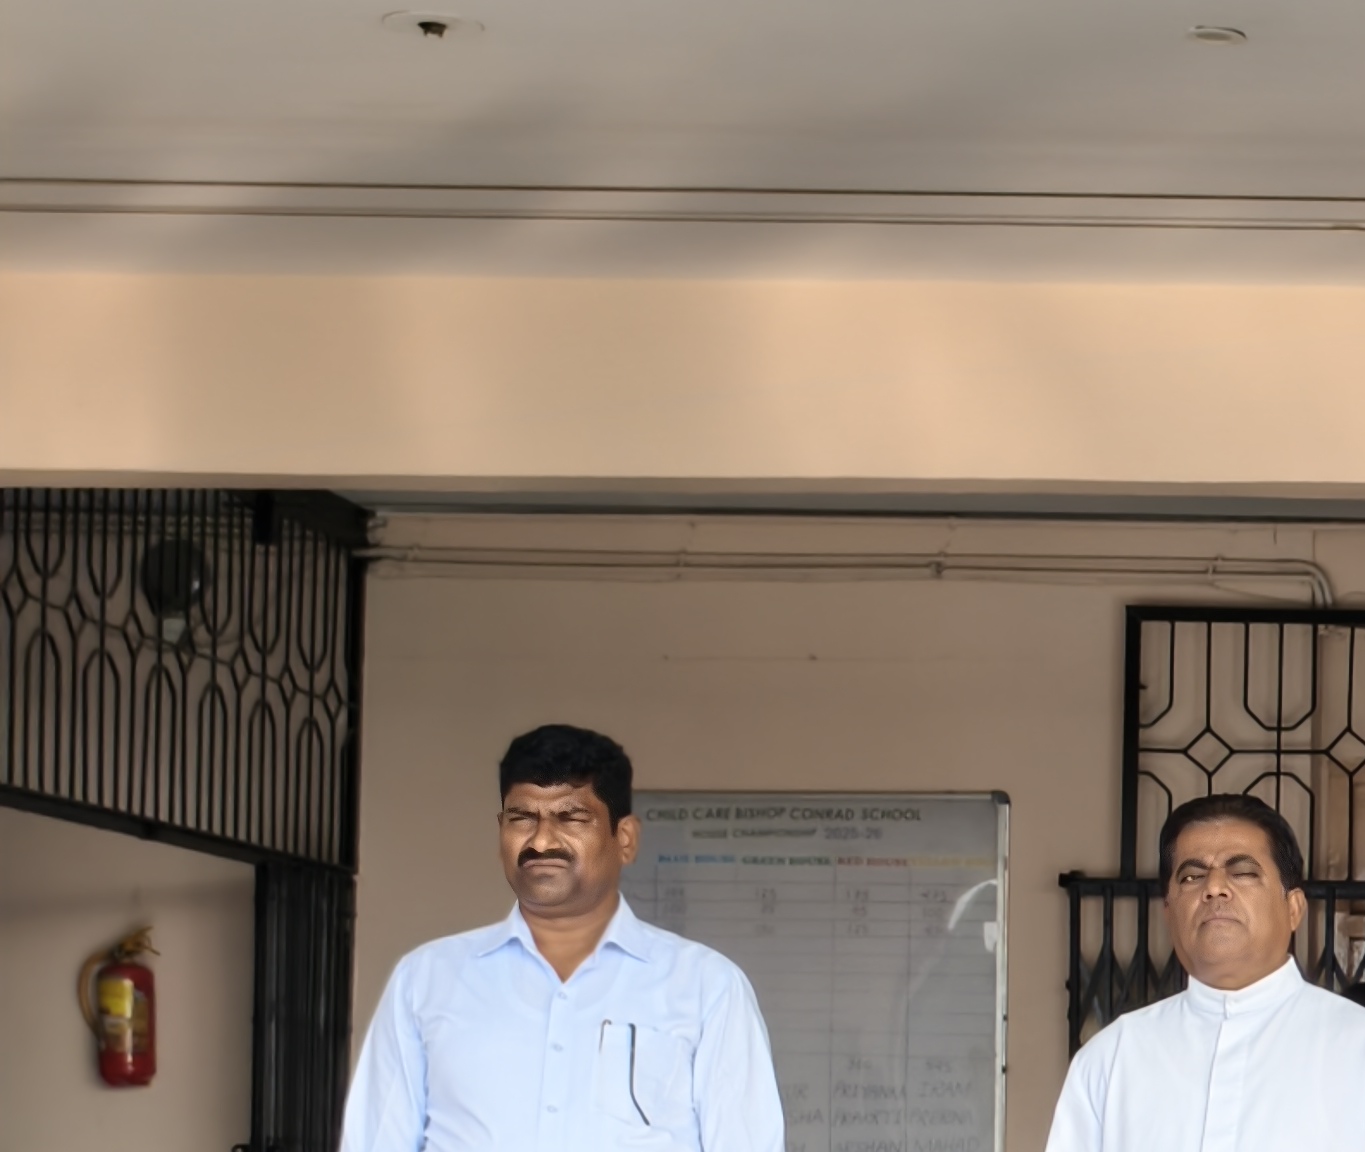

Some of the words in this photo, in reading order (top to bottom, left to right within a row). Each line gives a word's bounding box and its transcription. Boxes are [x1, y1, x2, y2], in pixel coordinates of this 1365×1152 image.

[645, 808, 689, 821] CHILD
[692, 807, 731, 820] CARE
[734, 807, 786, 820] BISHOP
[789, 807, 854, 820] CONRAD
[861, 807, 921, 821] SCHOOL
